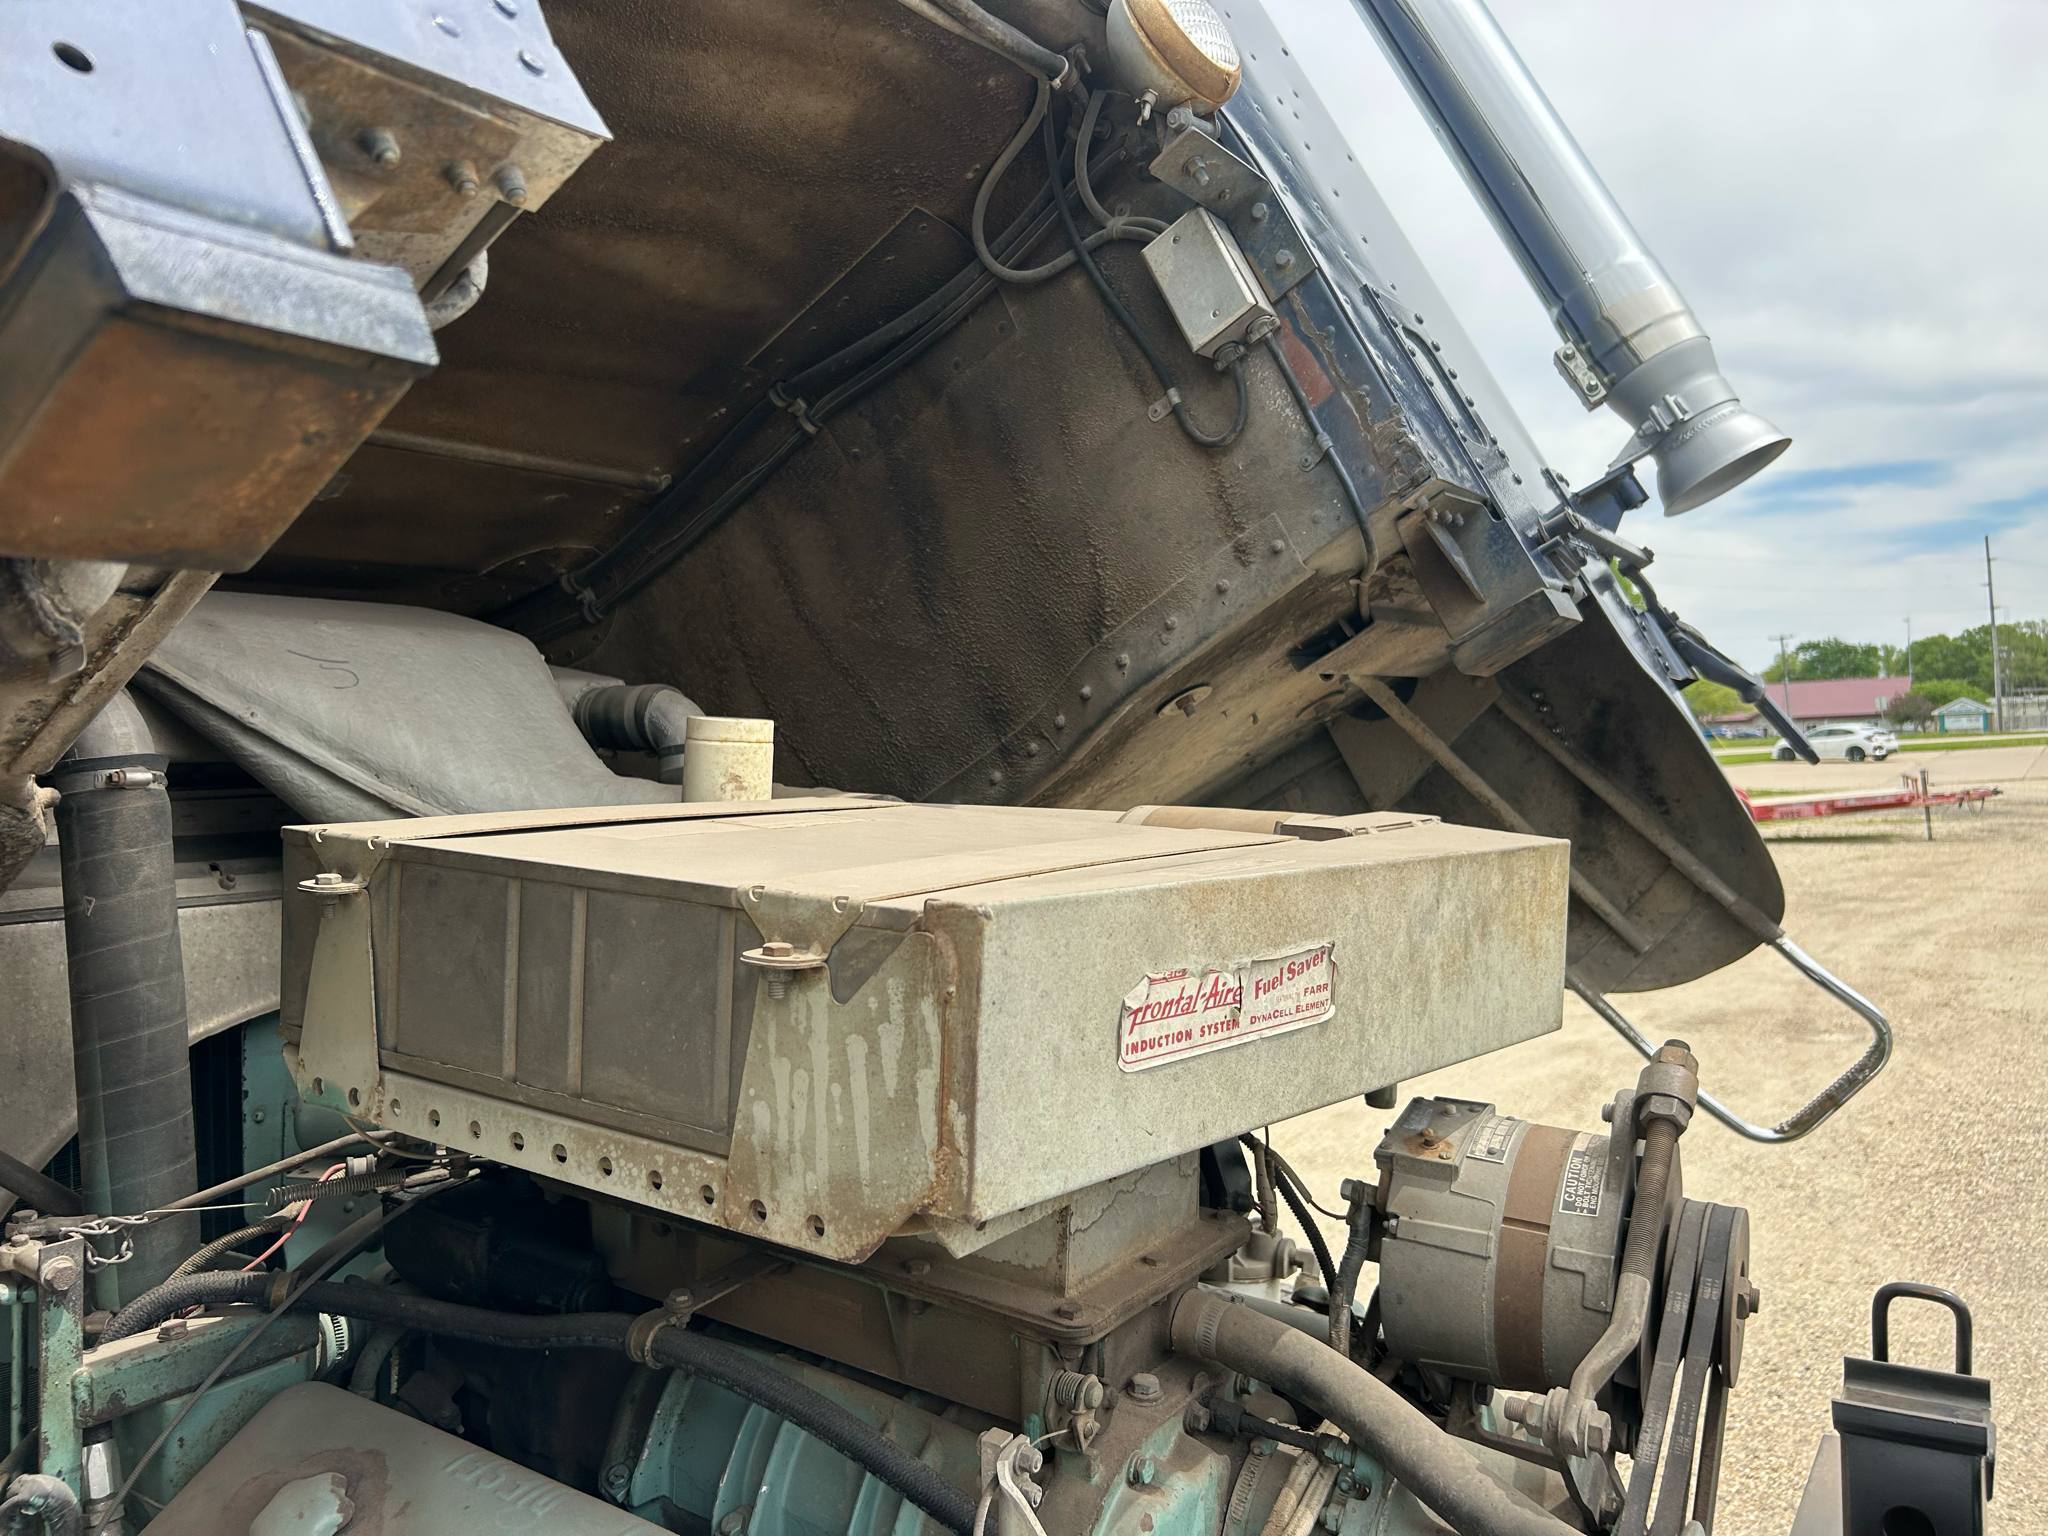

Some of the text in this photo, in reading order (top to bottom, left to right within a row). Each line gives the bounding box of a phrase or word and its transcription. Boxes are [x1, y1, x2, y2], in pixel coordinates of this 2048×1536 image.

[1254, 948, 1327, 1001] Fuel Saver
[1303, 983, 1329, 997] FARR
[1295, 998, 1329, 1014] ELEMENT
[1125, 1017, 1240, 1056] INDUCTION SYSTEM
[1564, 1157, 1583, 1201] CAUTION
[1577, 1181, 1585, 1195] NOT
[1575, 1196, 1583, 1207] DO
[1582, 1190, 1591, 1208] BOLT
[1590, 1195, 1598, 1209] END
